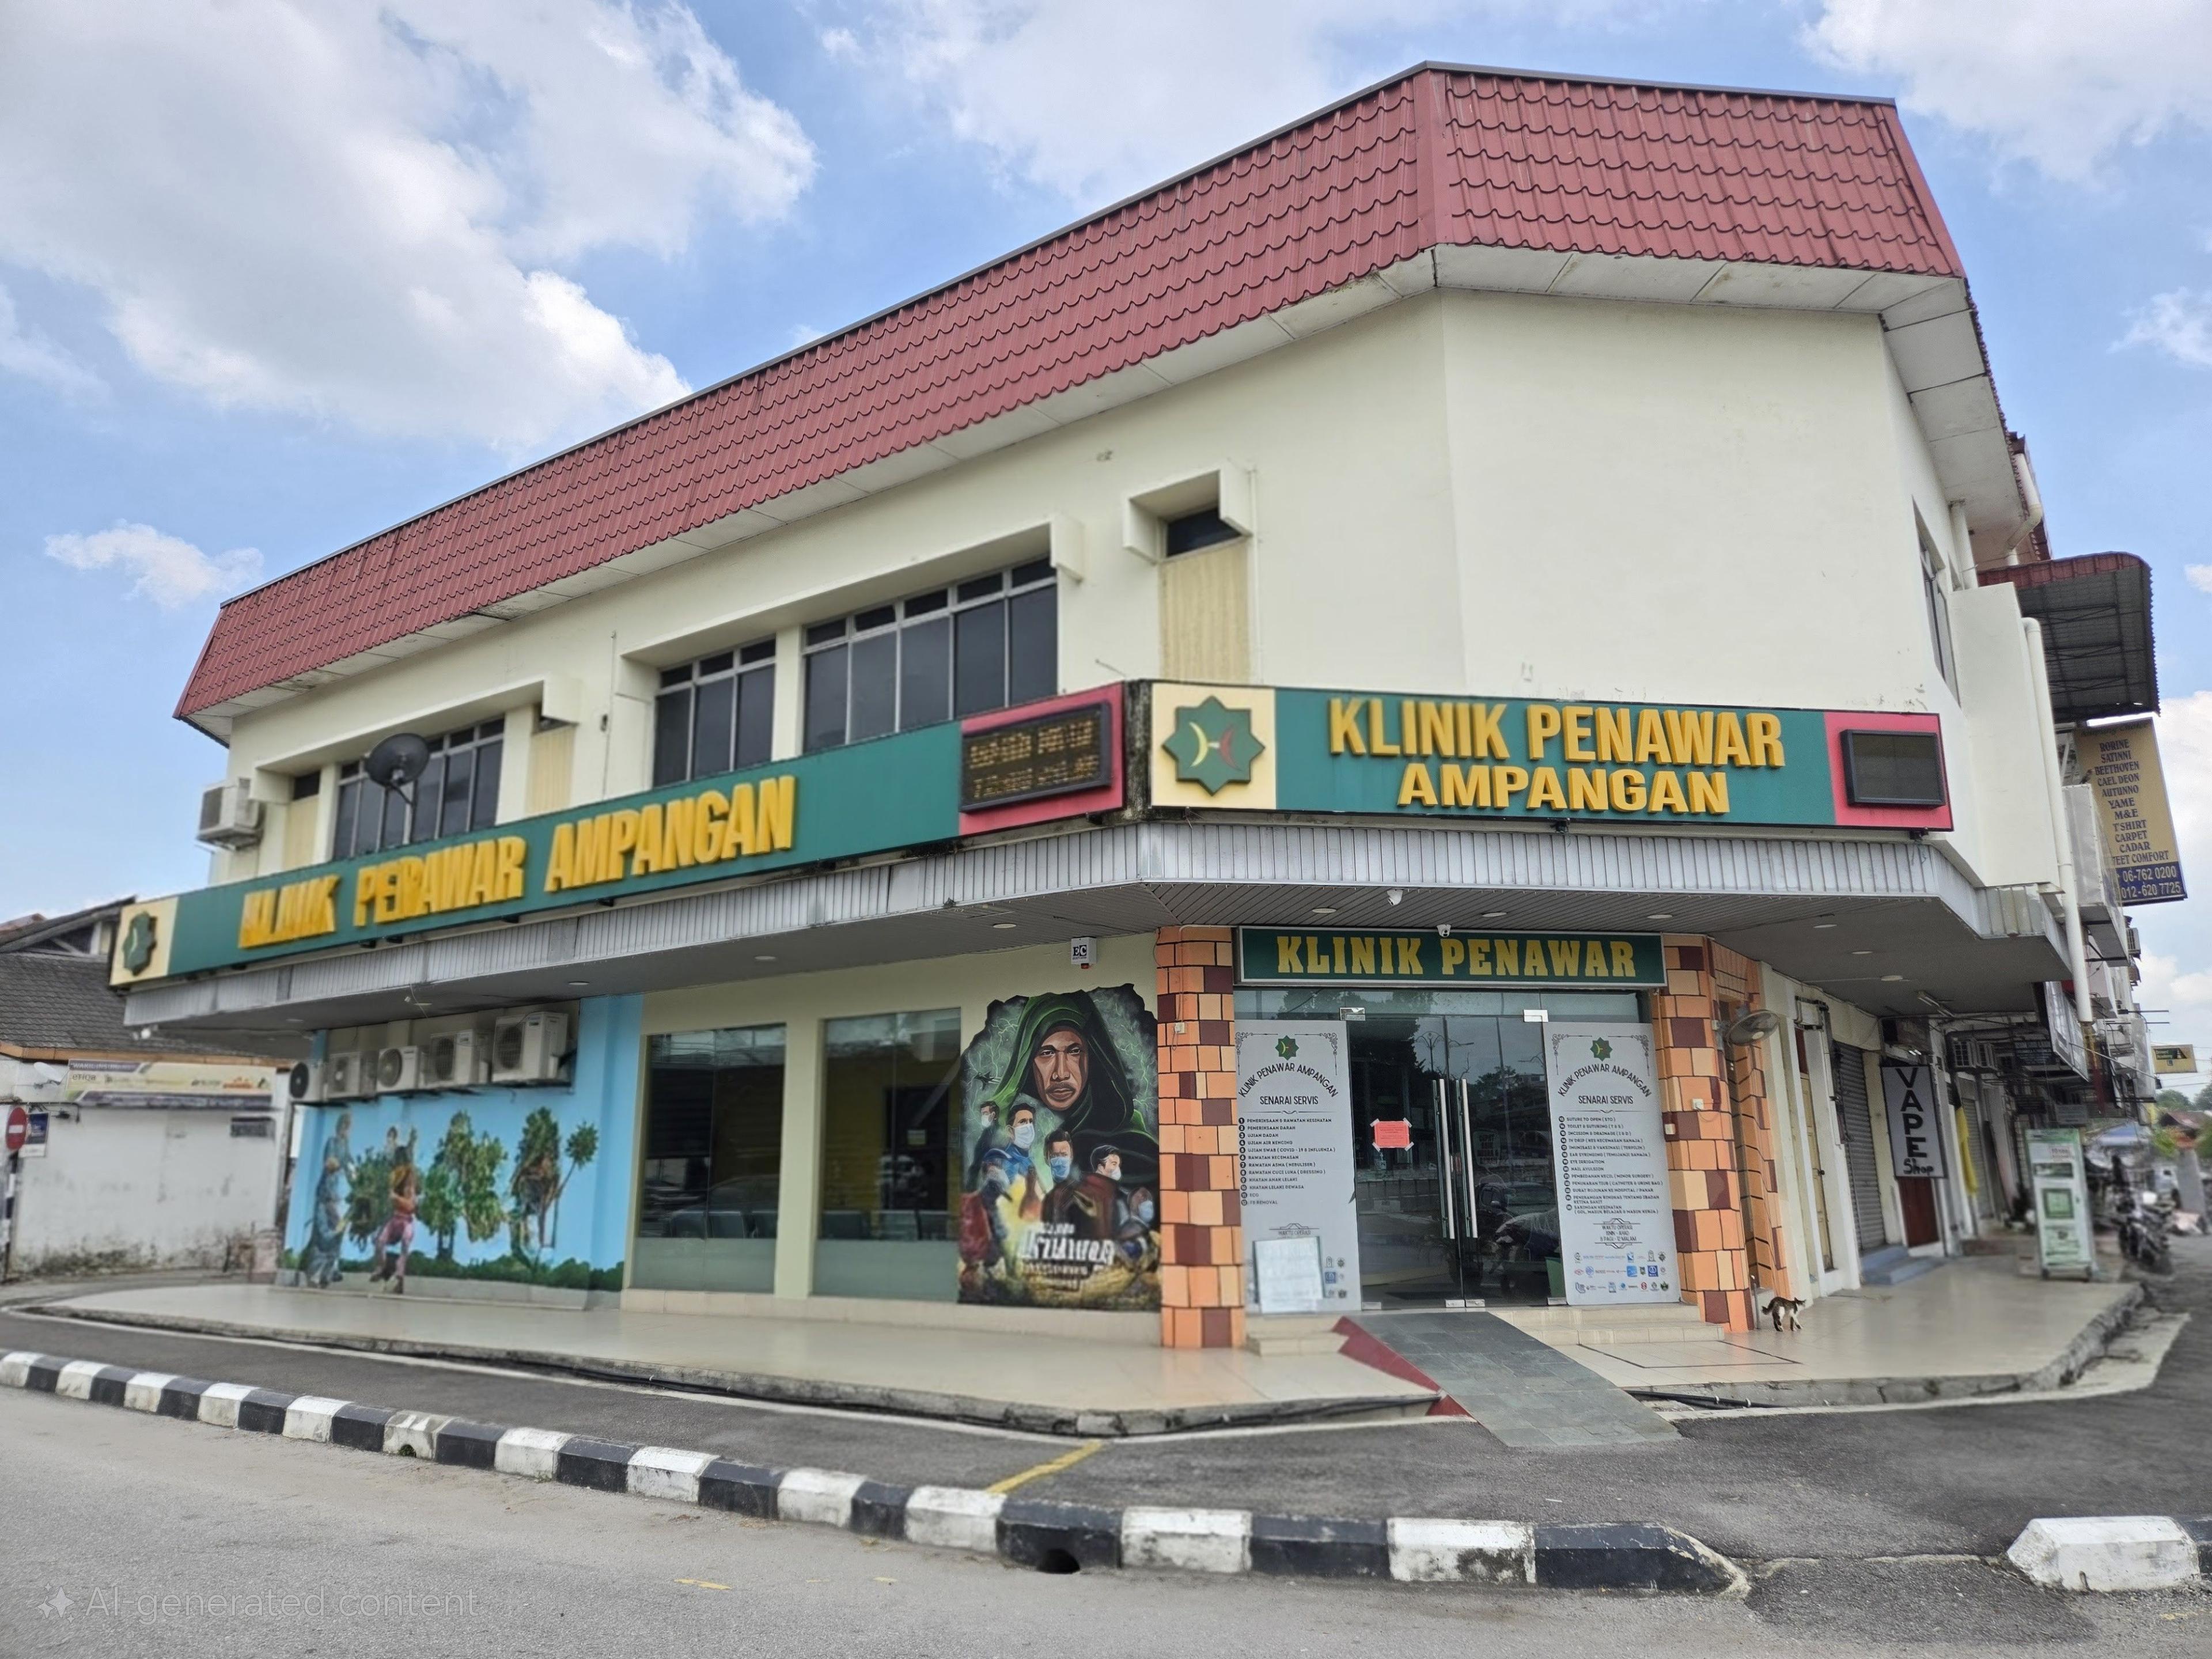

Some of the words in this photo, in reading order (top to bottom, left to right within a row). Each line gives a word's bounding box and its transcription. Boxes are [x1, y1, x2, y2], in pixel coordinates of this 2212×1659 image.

[1329, 698, 1510, 760] KLINIK
[1527, 704, 1785, 768] PENAWAR
[2094, 761, 2139, 775] BEETHOVEN
[2118, 773, 2139, 783] DEON
[1397, 763, 1730, 815] AMPANGAN
[2108, 797, 2135, 809] YAME
[2114, 809, 2138, 820] M&E
[543, 775, 796, 893] AMPANGAN
[2115, 830, 2147, 843] CARPET
[2119, 842, 2151, 853] CADAR
[2132, 850, 2169, 863] COMFORT
[2123, 868, 2153, 882] 06-762
[2155, 866, 2177, 879] 0200
[2121, 884, 2157, 899] 012-620
[2159, 881, 2180, 893] 7725
[1277, 936, 1423, 974] KLINIK
[1441, 938, 1636, 976] PENAWAR
[1238, 1075, 1259, 1097] KLINIK
[1257, 1063, 1295, 1080] PENAWAR
[1297, 1064, 1338, 1097] AMPANGAN
[1558, 1075, 1577, 1097] KLINIK
[1574, 1063, 1609, 1080] PENAWAR
[1612, 1065, 1652, 1097] AMPANGAN
[1260, 1096, 1291, 1104] SENARAI
[1294, 1096, 1318, 1104] SERVIS
[1579, 1096, 1608, 1104] SENARAI
[1610, 1096, 1633, 1104] SERVIS
[1895, 1067, 1927, 1157] VAPE
[1903, 1158, 1934, 1176] Shop
